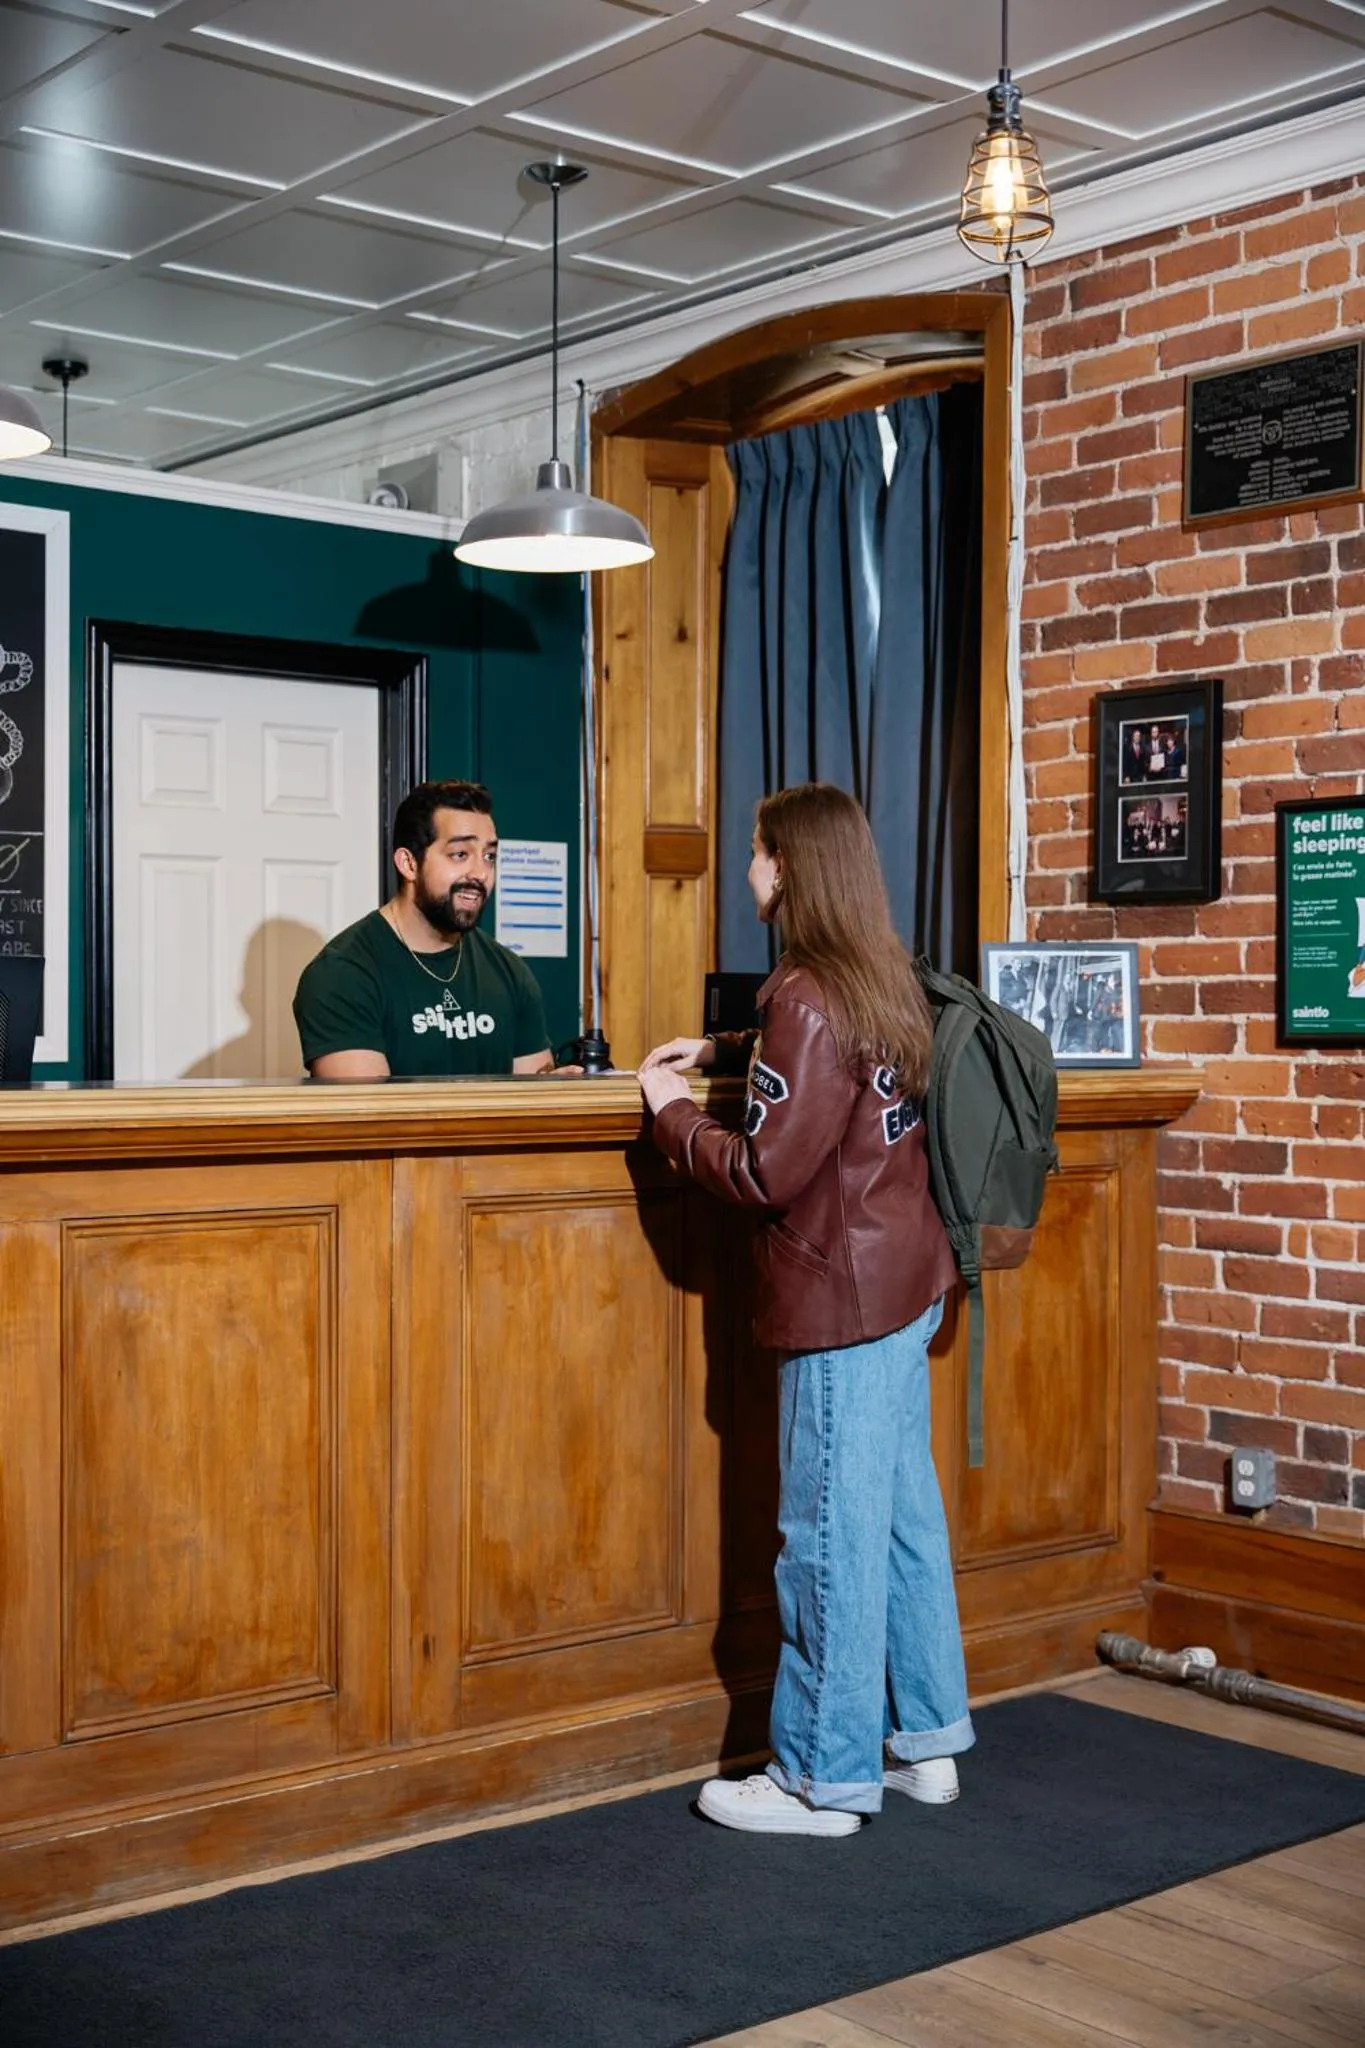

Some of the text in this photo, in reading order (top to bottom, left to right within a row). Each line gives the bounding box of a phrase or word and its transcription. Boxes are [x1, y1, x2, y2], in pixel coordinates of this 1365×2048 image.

[1293, 813, 1364, 834] feel like
[1293, 833, 1365, 855] sleeping
[1325, 861, 1334, 869] de
[1336, 860, 1352, 868] faire
[10, 898, 44, 915] SINCE
[1292, 1005, 1330, 1018] saintlo
[412, 1004, 495, 1040] saintlo
